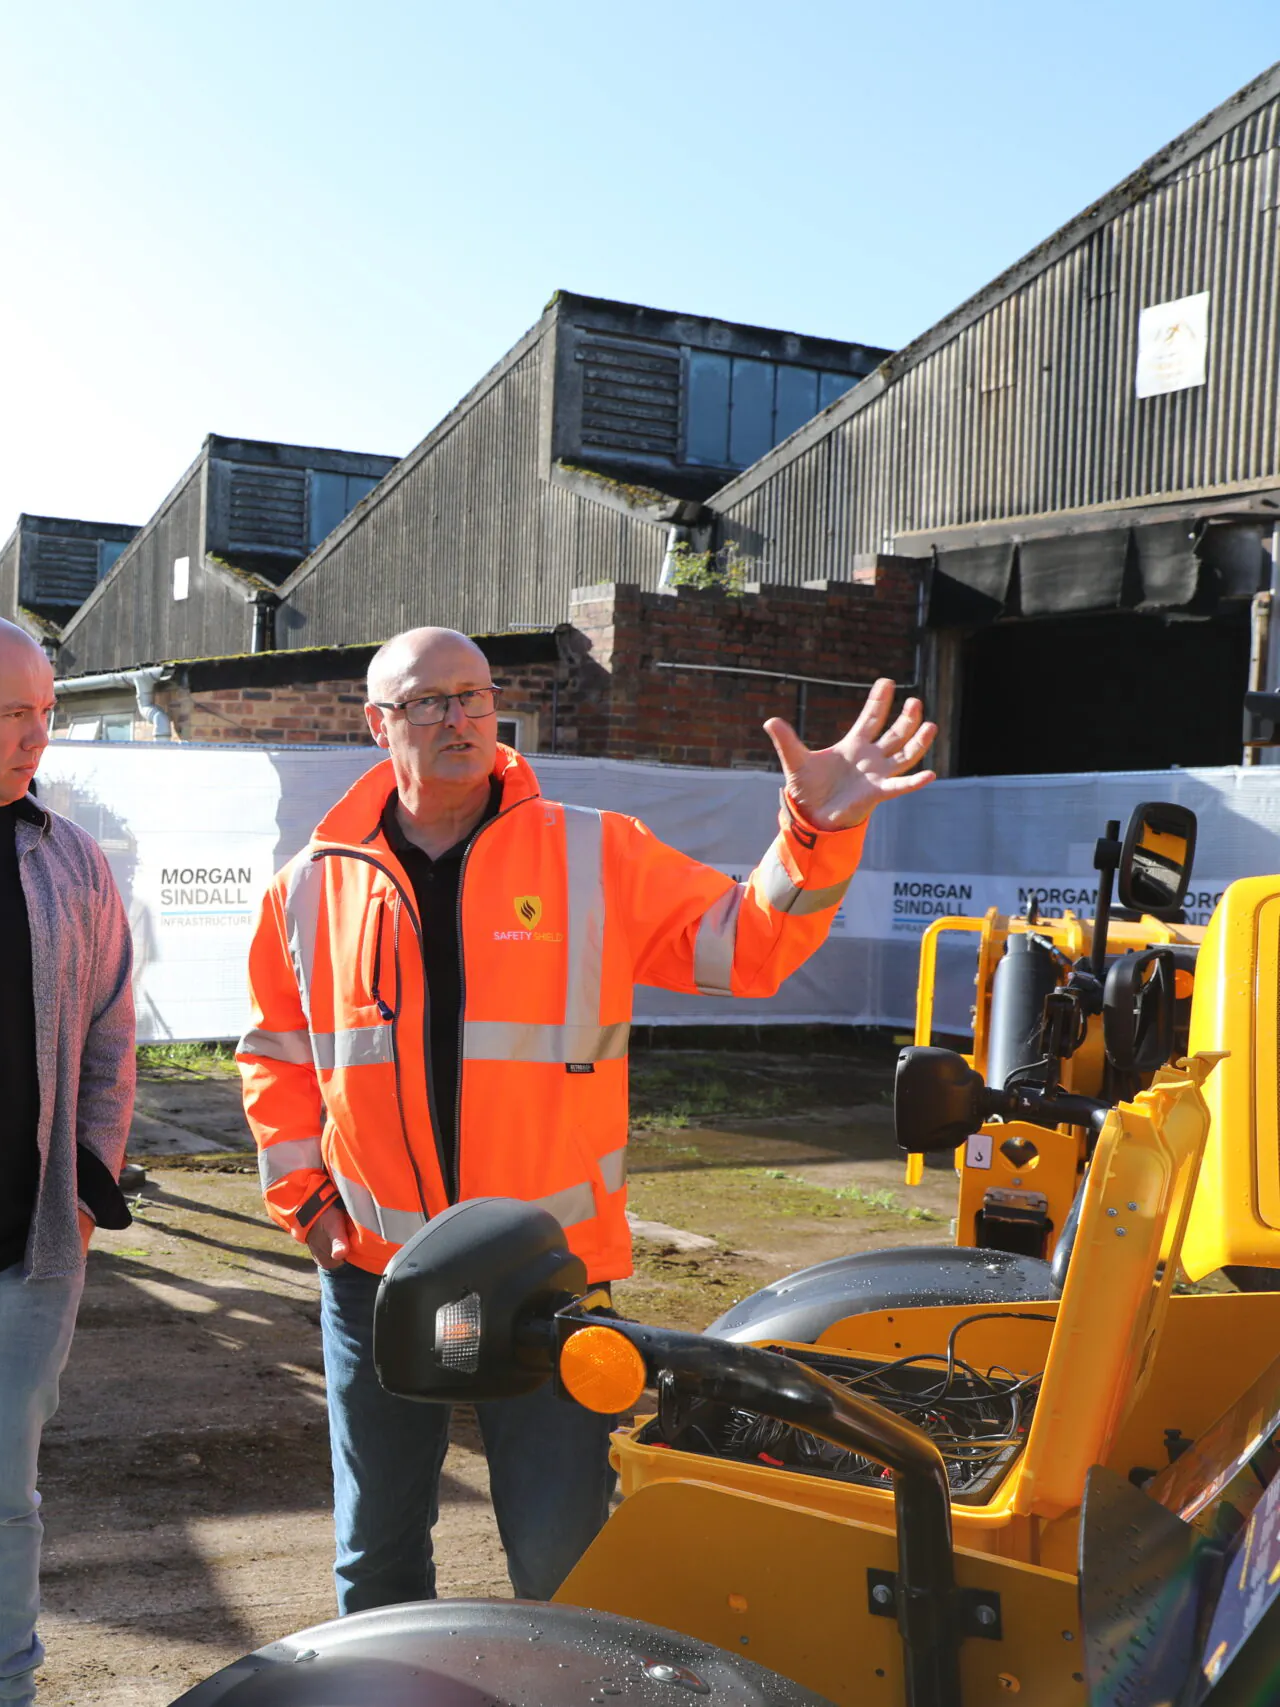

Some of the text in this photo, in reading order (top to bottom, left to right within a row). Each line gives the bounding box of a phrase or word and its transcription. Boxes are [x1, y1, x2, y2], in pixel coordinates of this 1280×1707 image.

[161, 867, 251, 885] MORGAN
[161, 888, 249, 906] SINDALL
[893, 881, 973, 900] MORGAN
[893, 899, 969, 917] SINDALL
[161, 915, 253, 928] INFRASTRUCTURE
[494, 931, 532, 941] SAFETY
